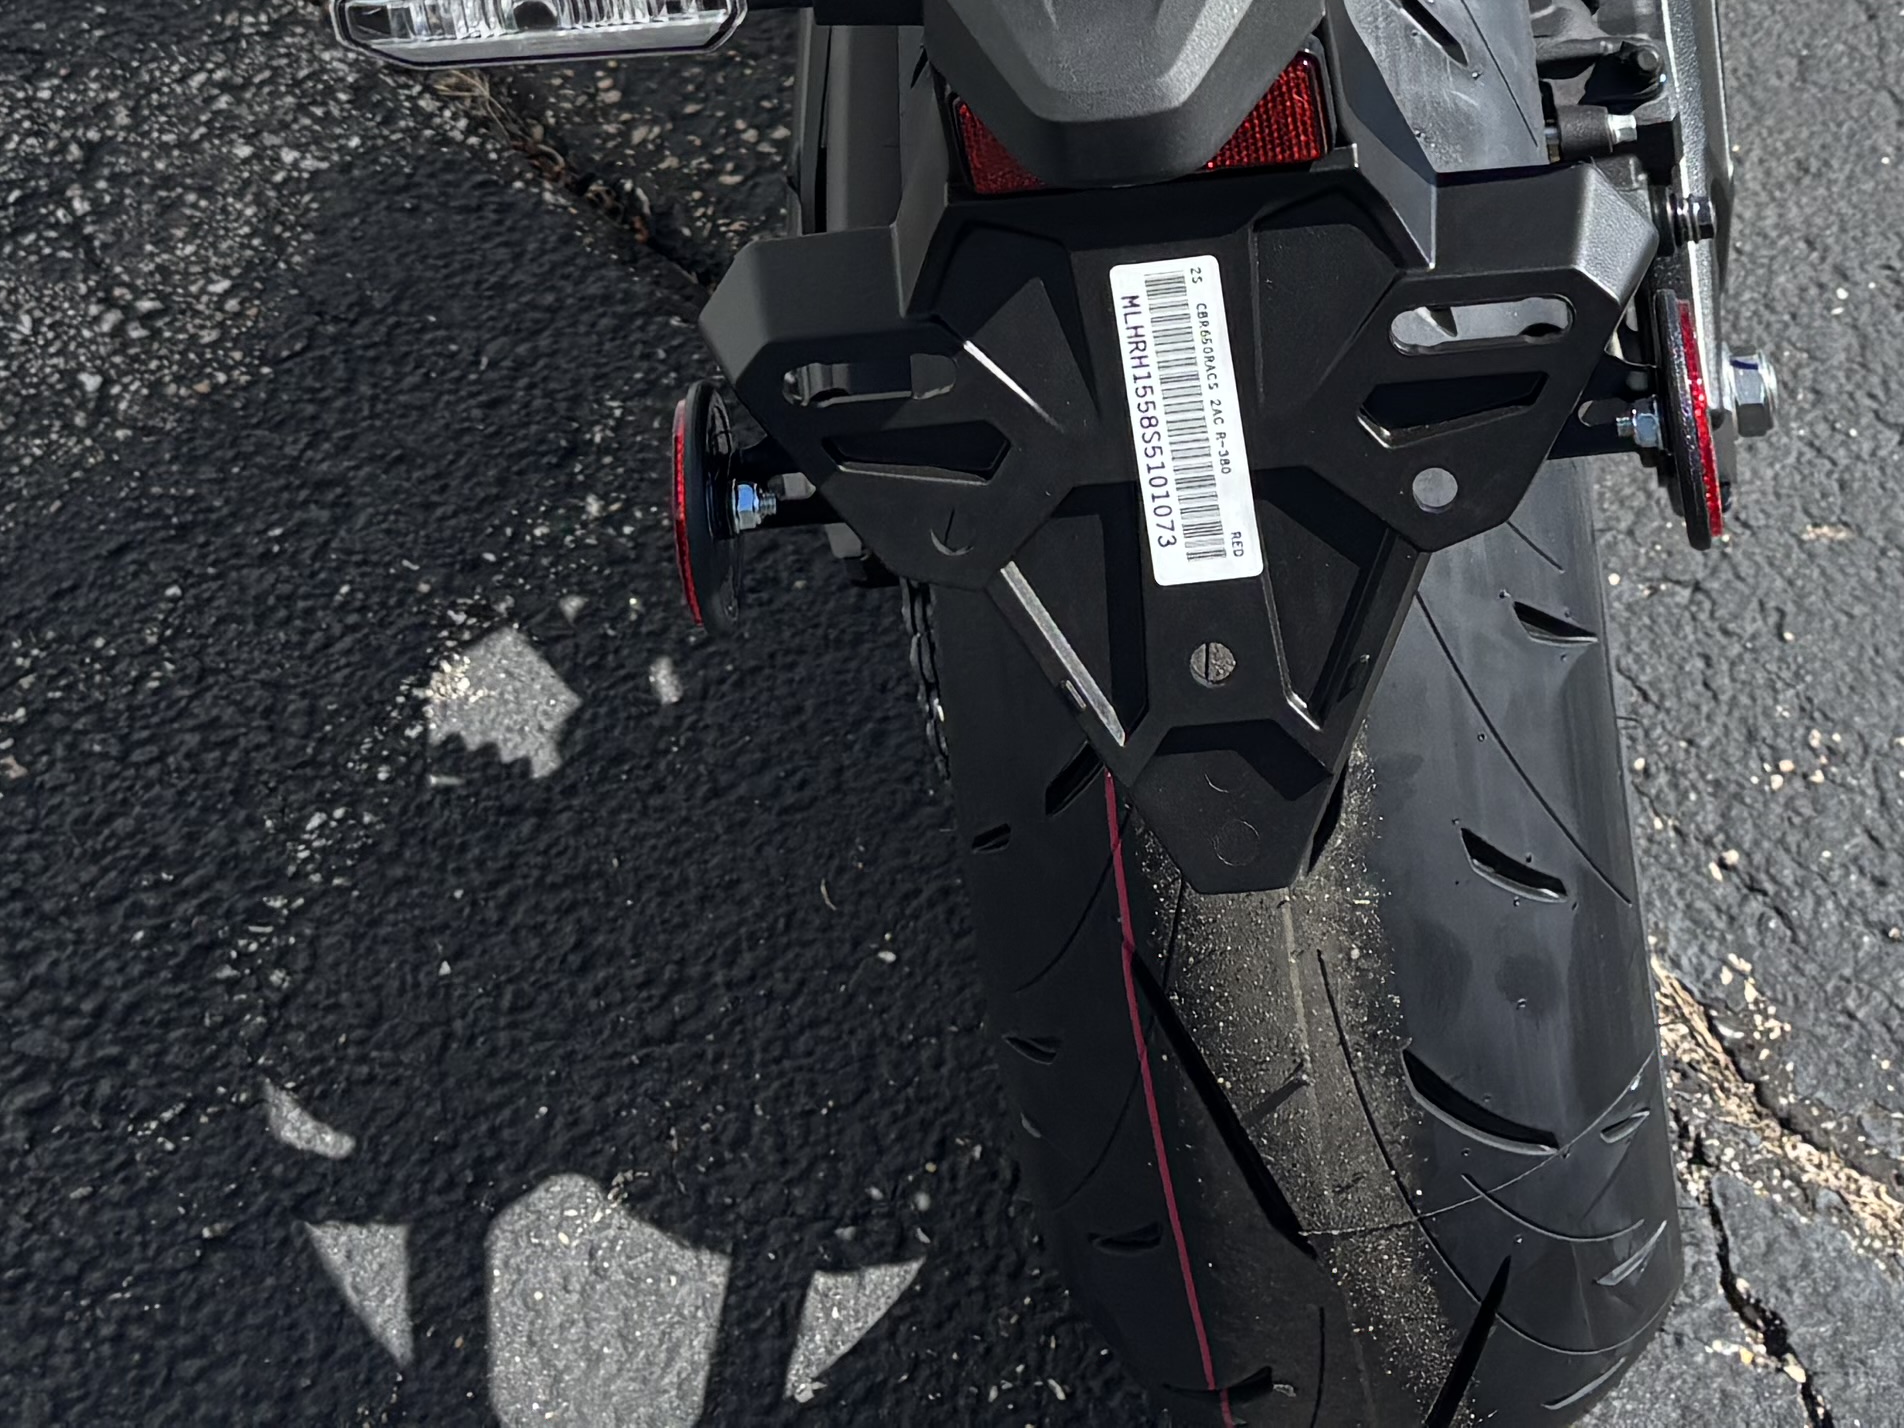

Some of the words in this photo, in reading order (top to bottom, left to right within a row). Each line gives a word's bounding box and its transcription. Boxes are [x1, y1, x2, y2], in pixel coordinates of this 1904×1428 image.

[1121, 295, 1177, 548] MLHRH1558S5101073
[1210, 399, 1225, 425] 2AC
[1230, 531, 1245, 557] RED
